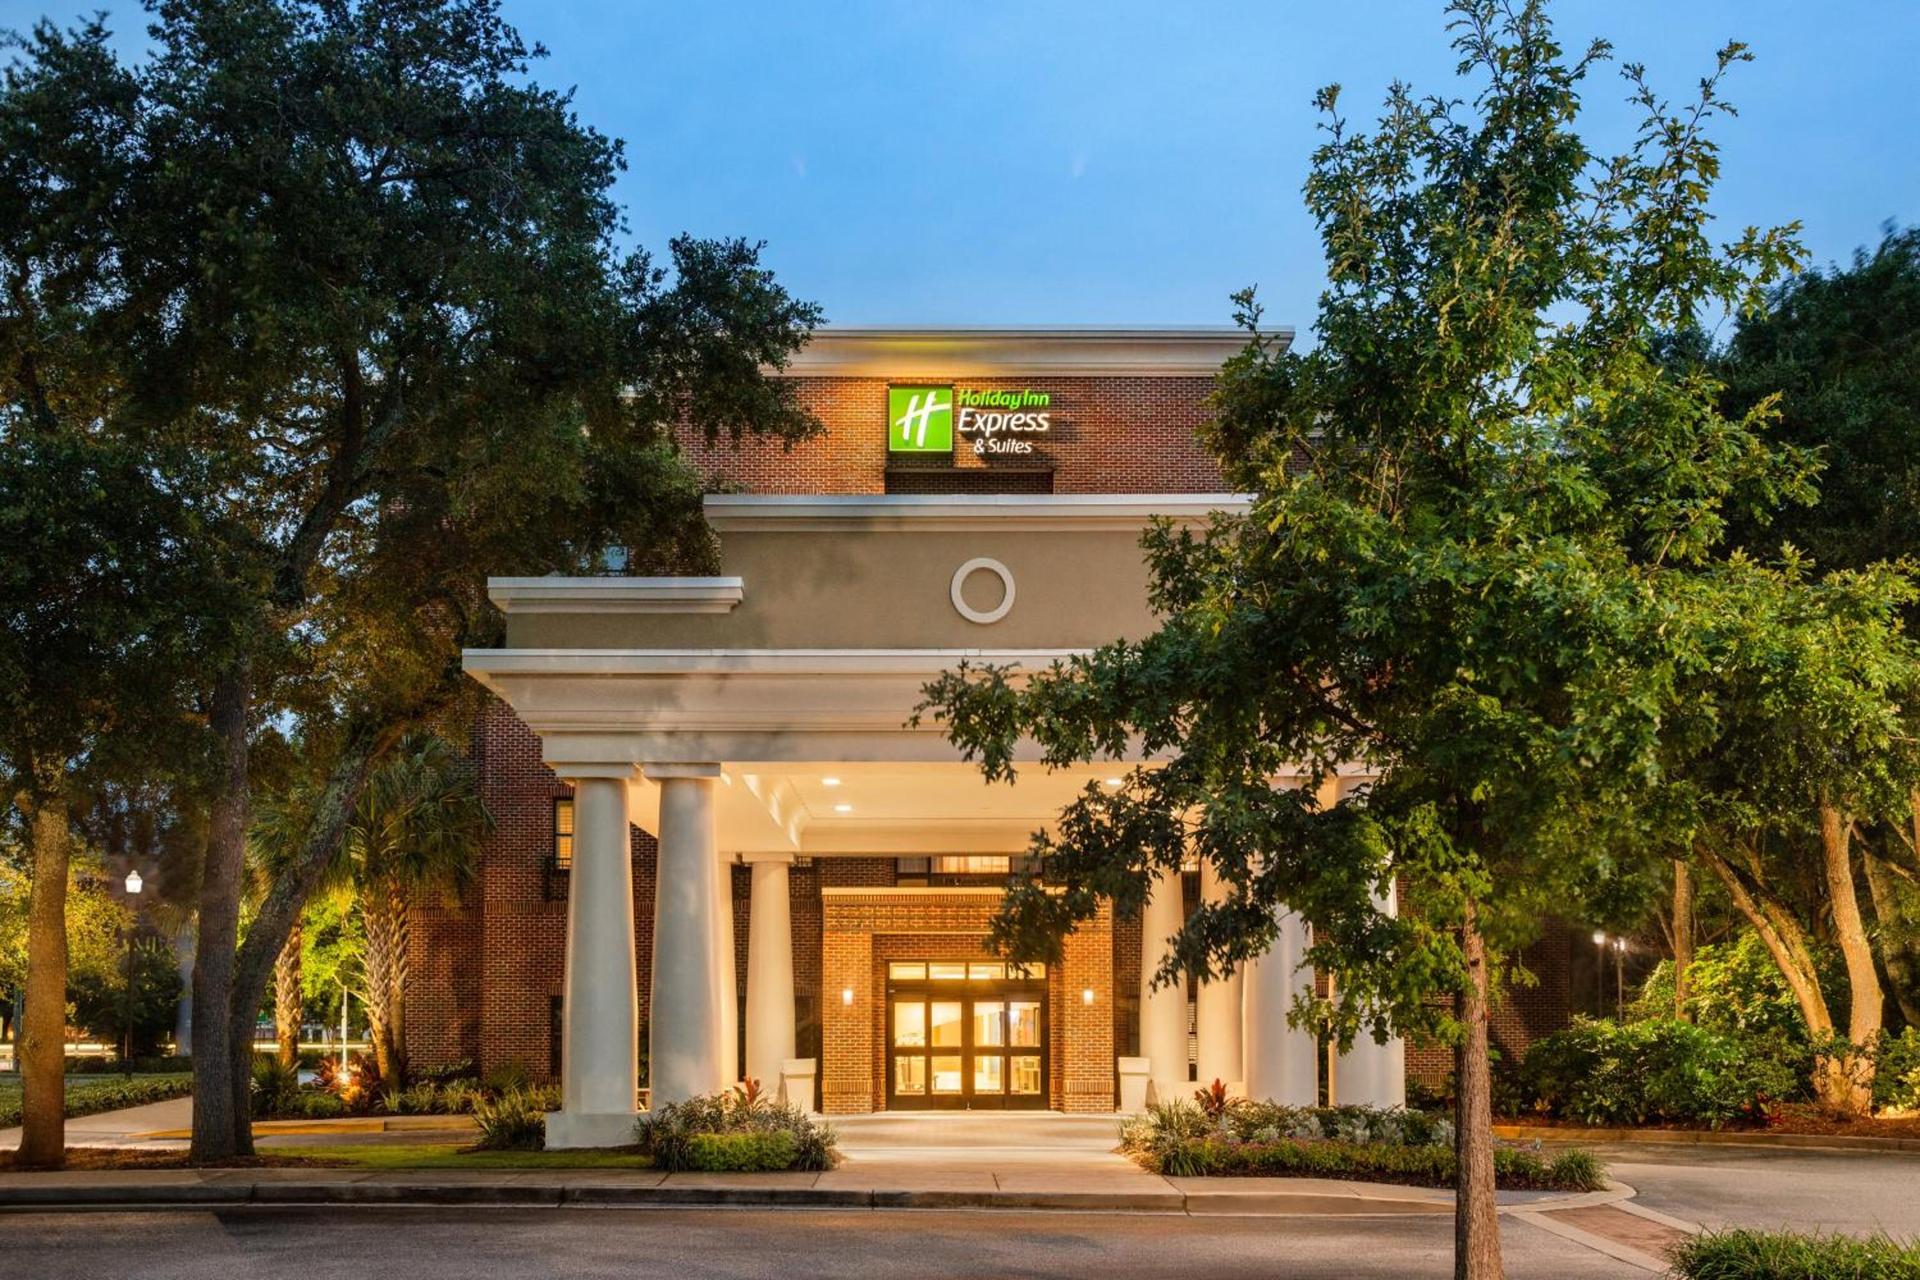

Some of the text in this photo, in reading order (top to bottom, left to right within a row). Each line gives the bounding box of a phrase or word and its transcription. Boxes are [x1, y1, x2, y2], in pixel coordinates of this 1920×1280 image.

[958, 389, 1049, 409] Holiday Inn
[958, 408, 1049, 437] Express
[974, 438, 1032, 454] & Suites
